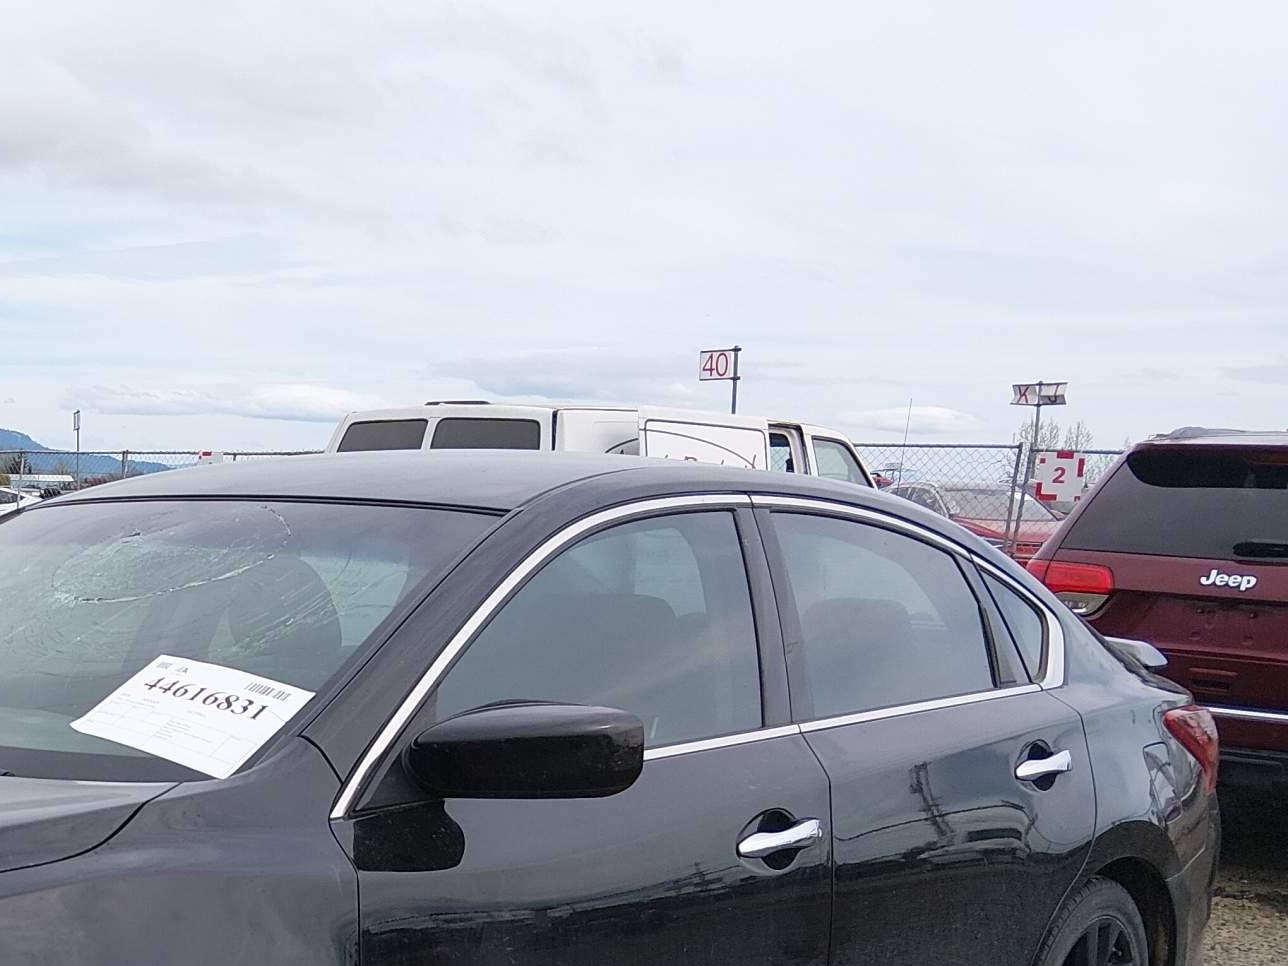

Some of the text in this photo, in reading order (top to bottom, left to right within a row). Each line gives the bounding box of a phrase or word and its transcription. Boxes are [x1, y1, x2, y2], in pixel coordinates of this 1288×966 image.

[702, 352, 729, 377] 40
[1052, 466, 1066, 484] 2
[1199, 569, 1257, 591] Jeep
[144, 676, 269, 721] 44616831
